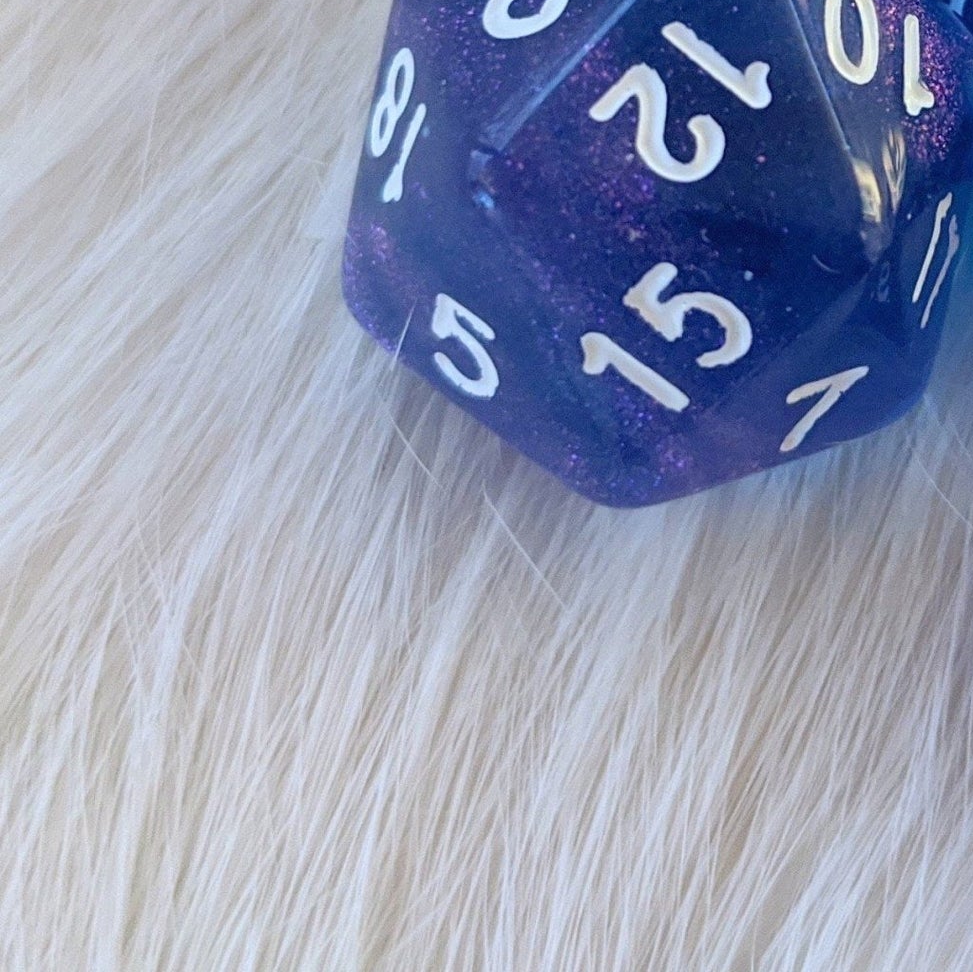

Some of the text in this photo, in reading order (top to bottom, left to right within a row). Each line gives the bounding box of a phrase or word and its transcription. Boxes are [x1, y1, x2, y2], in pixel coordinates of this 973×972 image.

[371, 48, 427, 202] 18
[588, 21, 773, 183] 12
[431, 293, 499, 397] 5
[581, 262, 752, 413] 15
